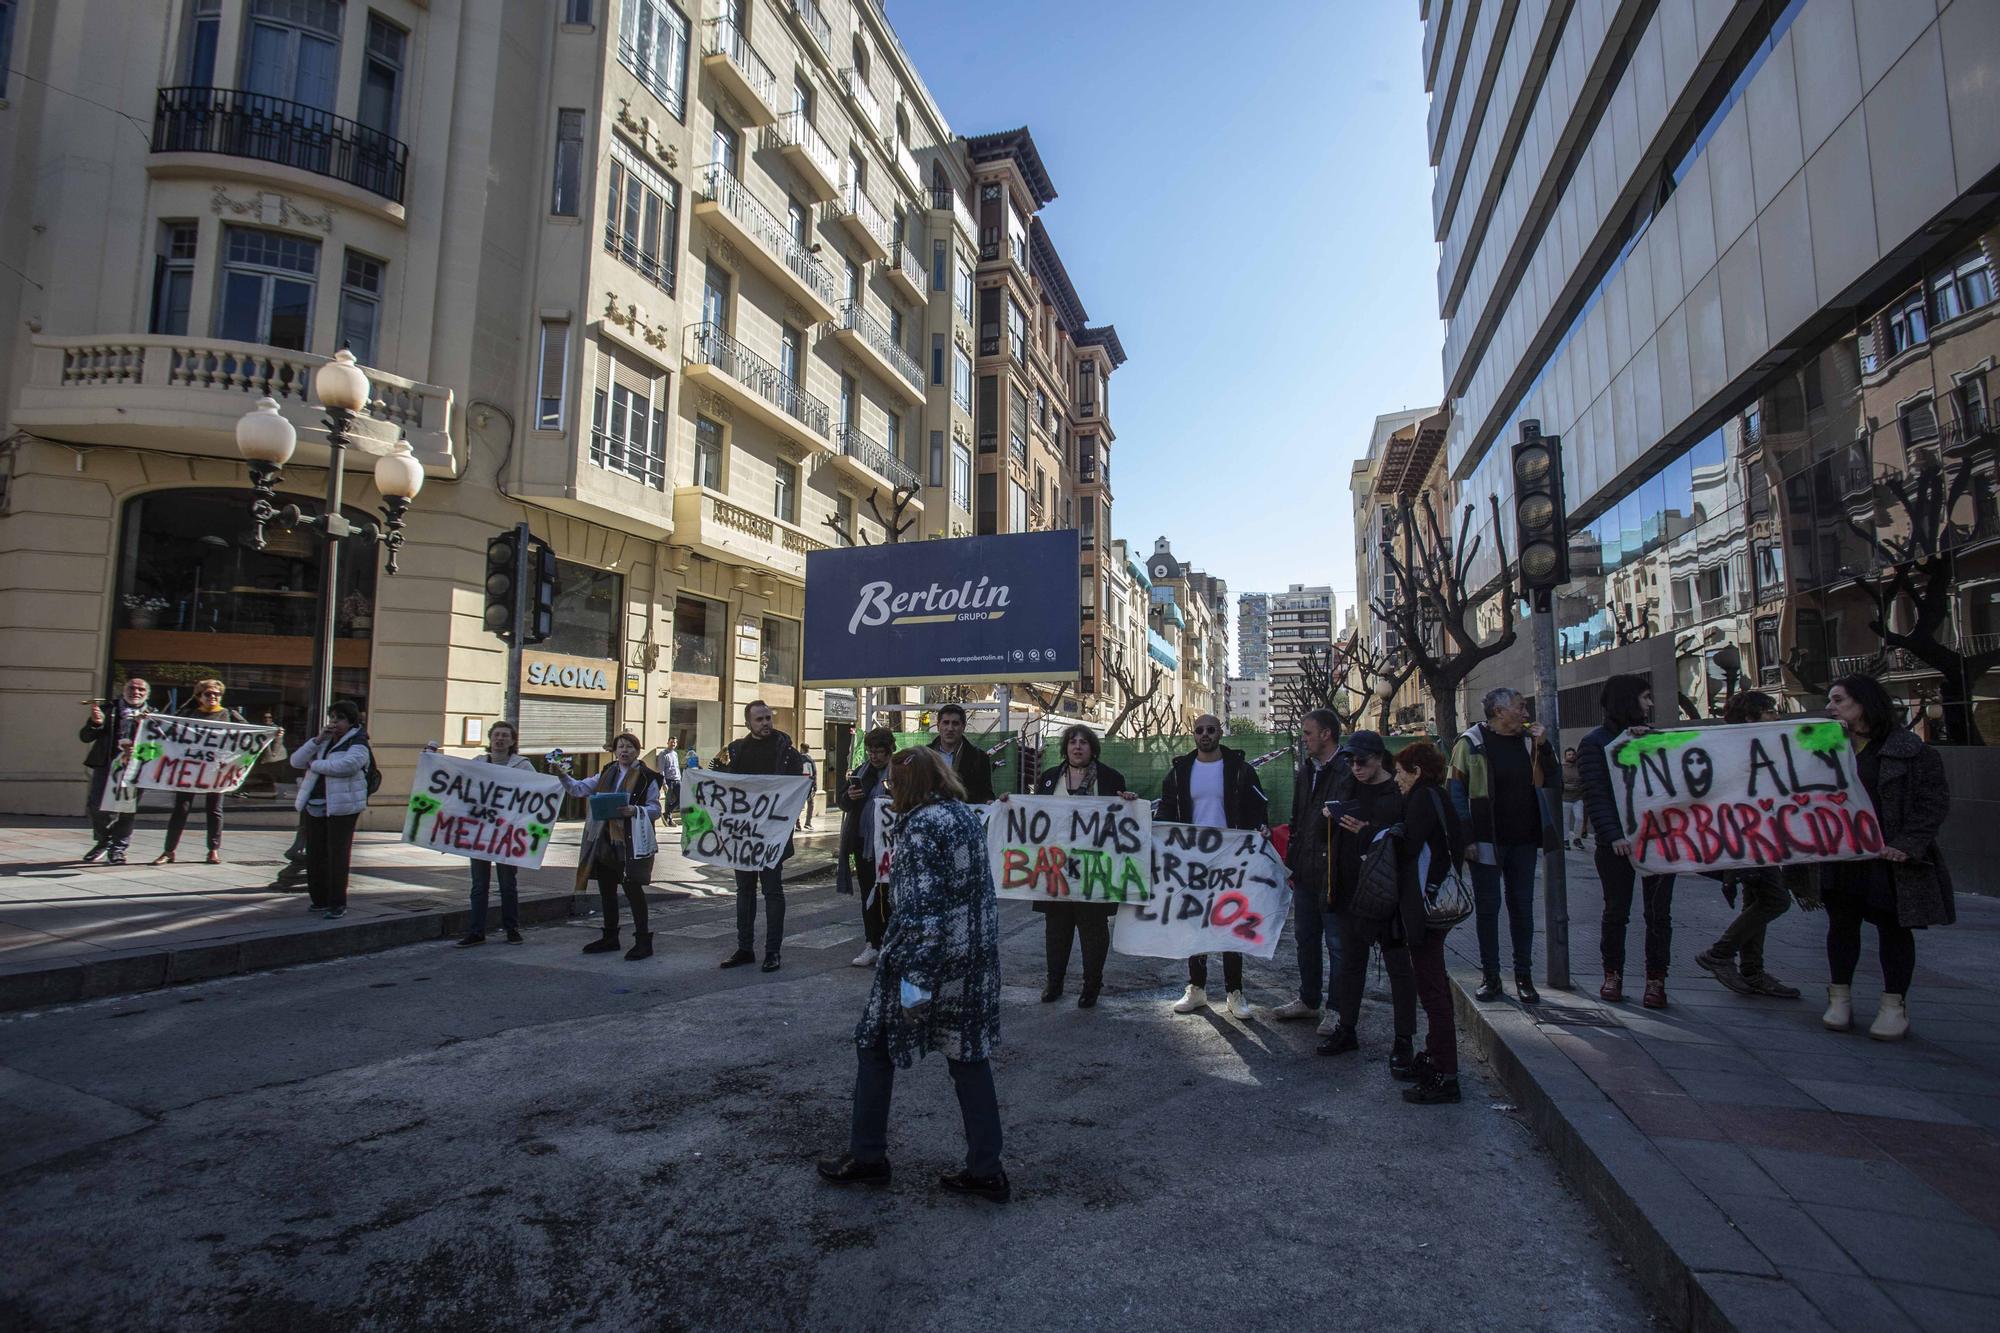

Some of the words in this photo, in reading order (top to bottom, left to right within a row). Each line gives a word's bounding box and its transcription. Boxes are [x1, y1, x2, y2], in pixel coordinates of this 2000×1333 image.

[848, 575, 1011, 635] Bertolín
[957, 611, 988, 621] GRUPO
[940, 653, 1004, 663] www.grupobertolin.es
[527, 661, 608, 690] SAONA
[146, 721, 268, 755] SALVEMOS
[184, 747, 215, 762] LAS
[1639, 747, 1714, 798] NO
[428, 769, 558, 824] SALVEMOS
[470, 806, 498, 823] LAS
[1007, 806, 1051, 844] NO
[1070, 803, 1141, 854] MÁS
[1164, 827, 1223, 853] NO
